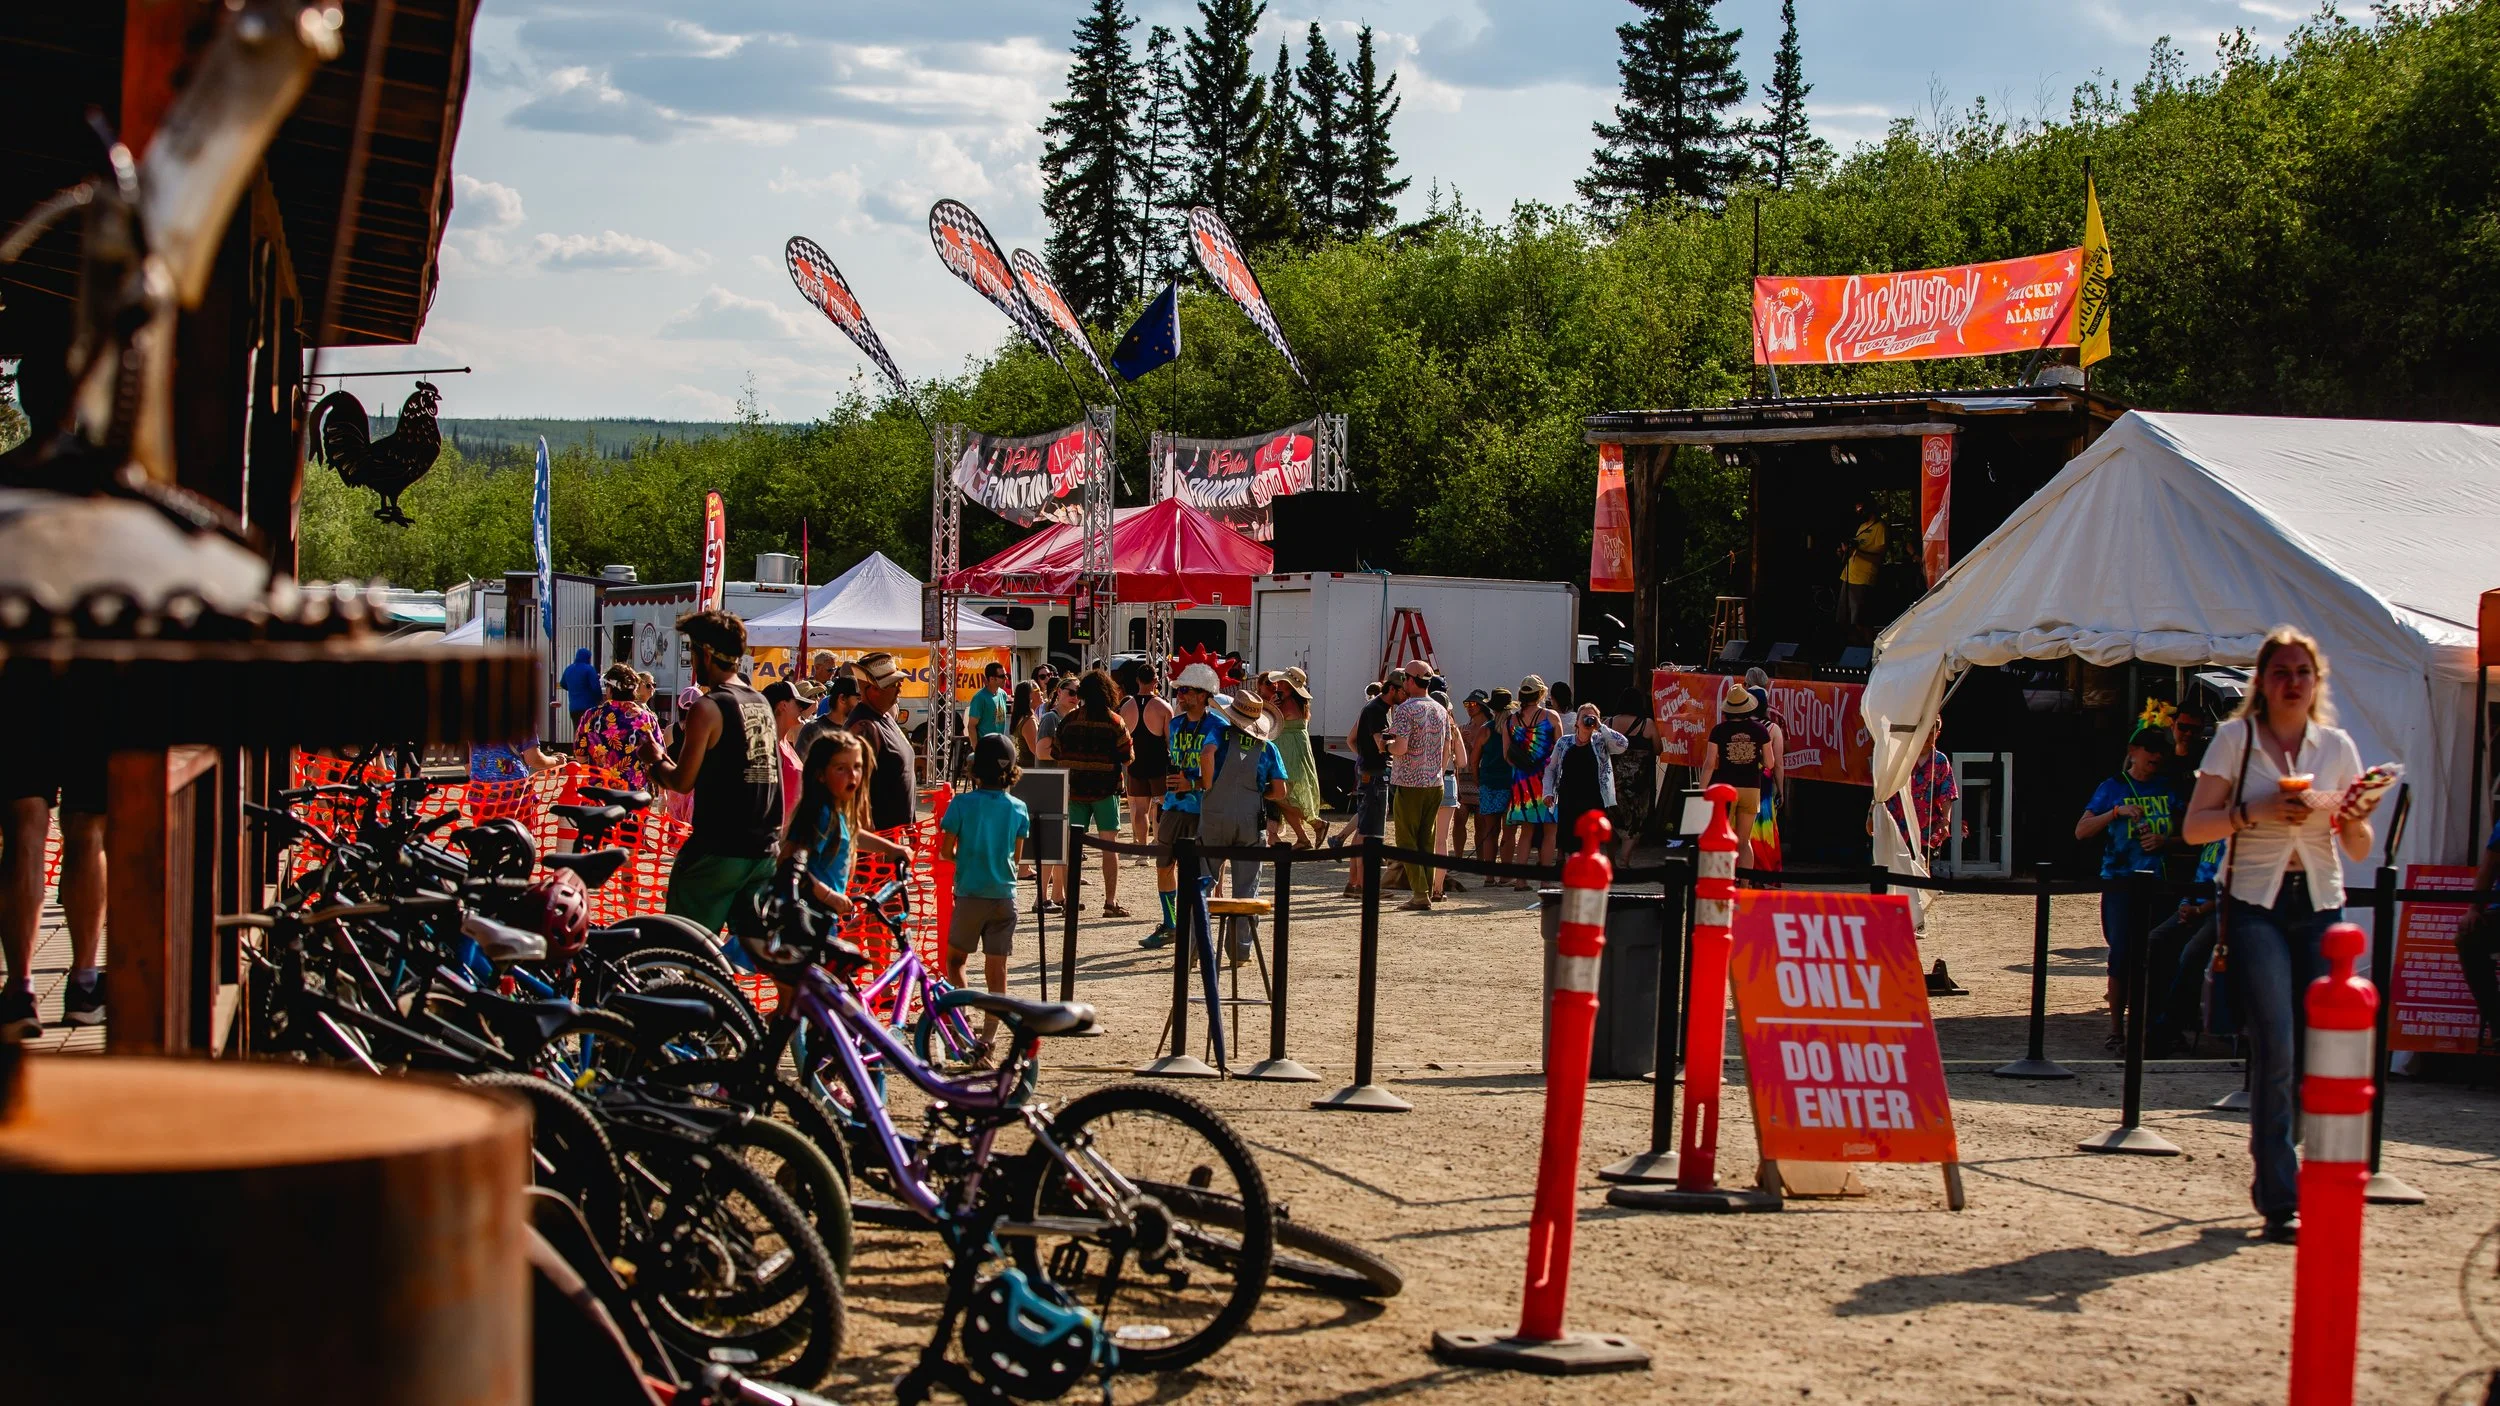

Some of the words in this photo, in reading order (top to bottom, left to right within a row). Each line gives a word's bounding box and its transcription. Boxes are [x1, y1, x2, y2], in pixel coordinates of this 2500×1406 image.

[1777, 287, 1790, 299] TOP
[1791, 287, 1799, 296] OF
[1800, 290, 1814, 310] THE
[2005, 281, 2063, 301] CHICKEN
[1825, 269, 1982, 364] CHICKENSTOCK
[2005, 305, 2055, 325] ALASKA
[1858, 337, 1893, 353] MUSIC
[1889, 332, 1934, 352] FESTIVAL
[1660, 687, 1691, 722] Cluck
[1783, 752, 1818, 767] FESTIVAL
[1771, 913, 1867, 961] EXIT
[1775, 961, 1881, 1010] ONLY
[2397, 1010, 2414, 1021] ALL
[2416, 1011, 2474, 1024] PASSENGERS
[2401, 1024, 2425, 1035] HOLD
[1779, 1041, 1834, 1082] DO
[1839, 1042, 1908, 1084] NOT
[1794, 1087, 1915, 1129] ENTER
